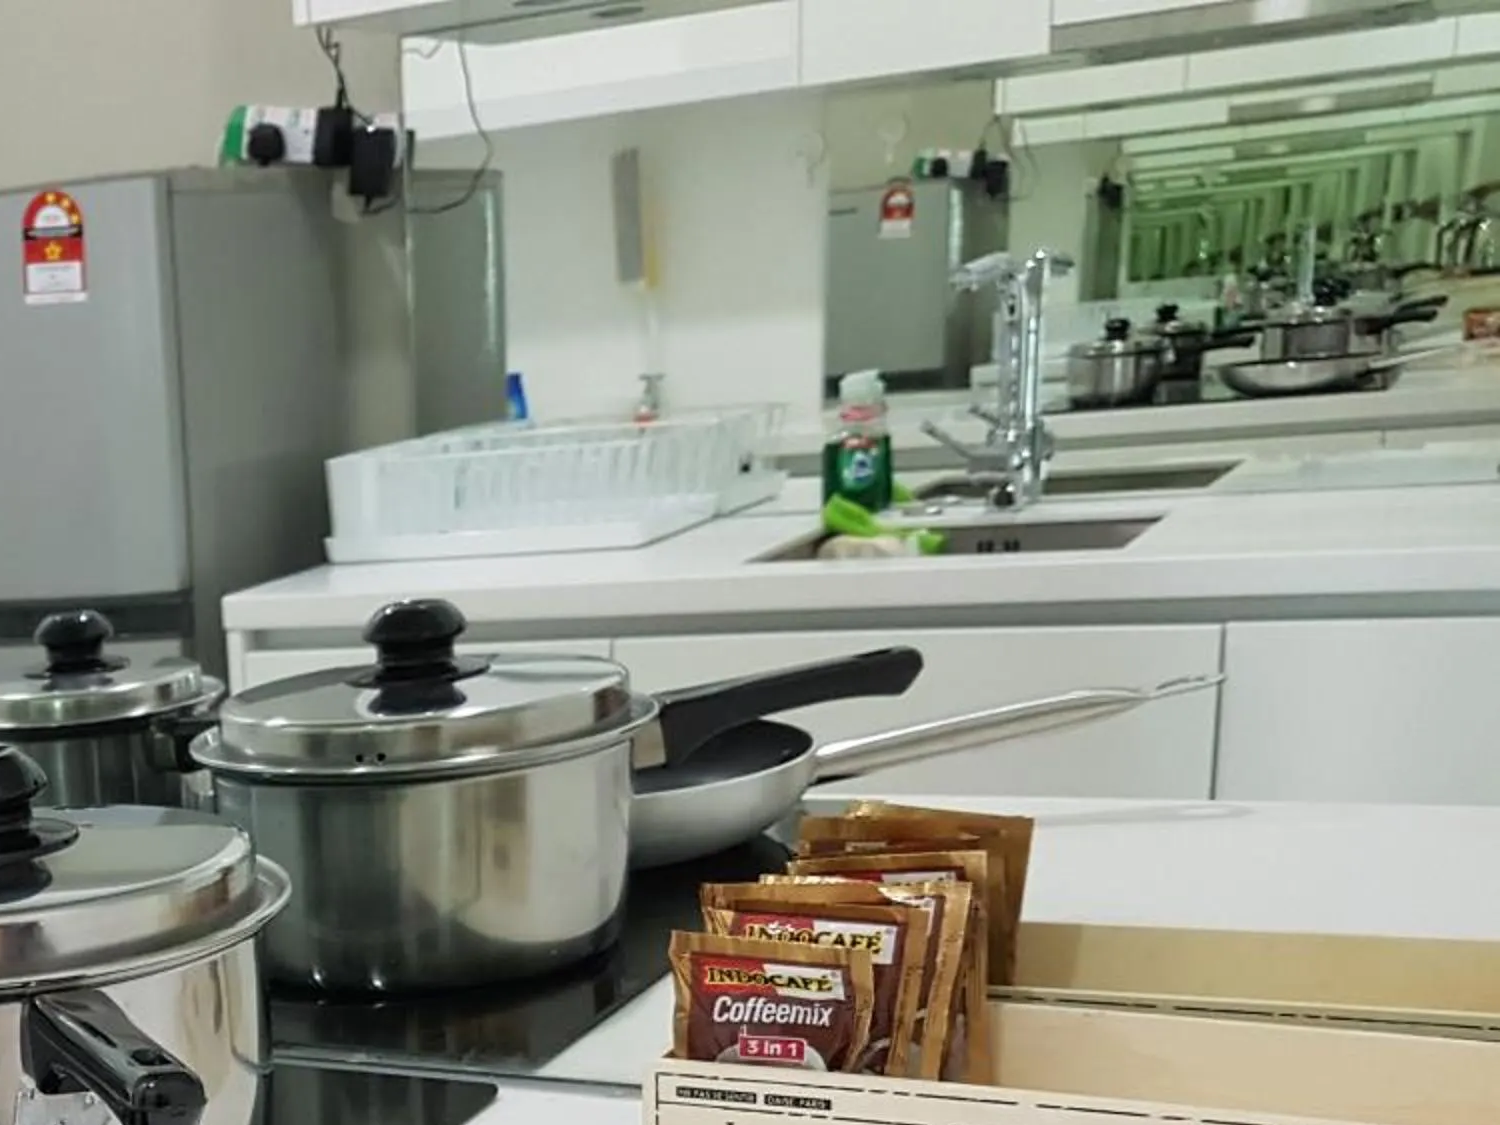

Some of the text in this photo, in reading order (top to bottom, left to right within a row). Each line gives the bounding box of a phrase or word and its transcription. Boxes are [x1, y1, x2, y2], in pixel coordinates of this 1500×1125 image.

[707, 966, 833, 992] INDOCAFÉ
[713, 996, 833, 1027] Coffeemix
[746, 1039, 758, 1054] 3
[787, 1042, 798, 1057] 1
